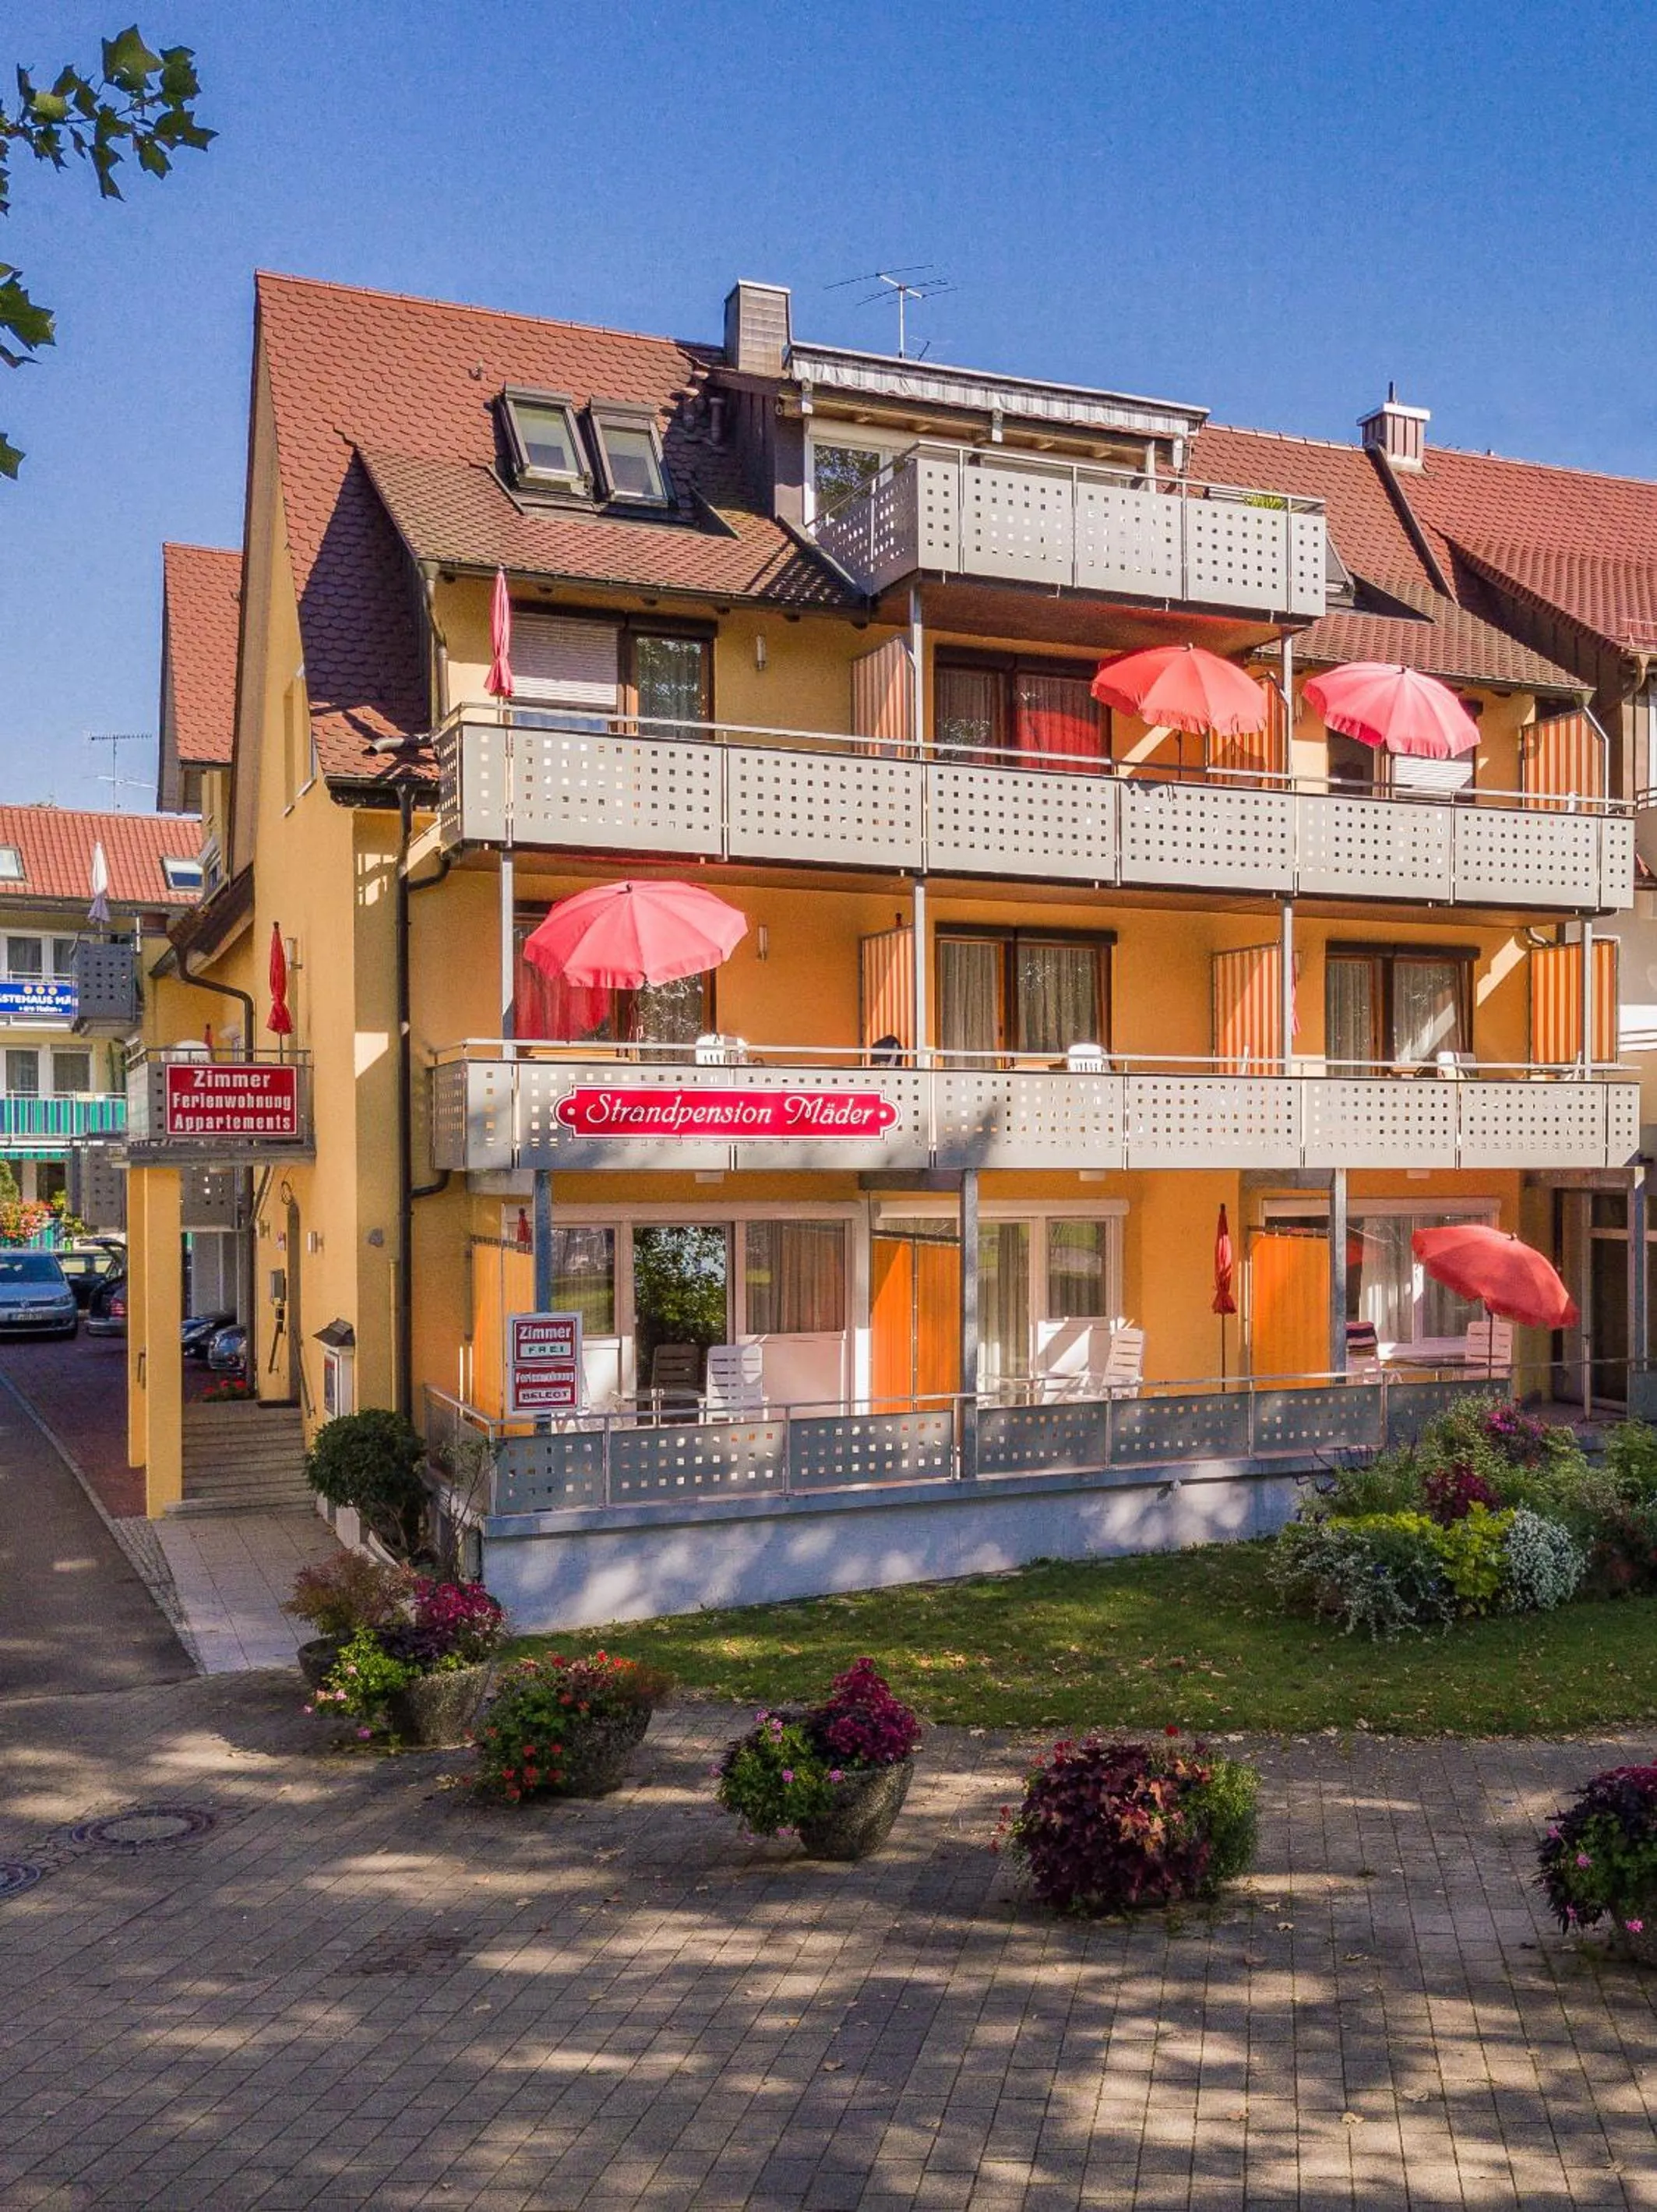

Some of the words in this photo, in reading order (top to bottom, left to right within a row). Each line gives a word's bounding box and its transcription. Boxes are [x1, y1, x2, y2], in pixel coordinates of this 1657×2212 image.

[0, 993, 54, 1004] STEHAUS
[193, 1070, 270, 1088] Zimmer
[172, 1092, 291, 1110] Ferienwohnung
[586, 1093, 771, 1130] Strandpension
[784, 1095, 873, 1125] Mäder
[175, 1113, 291, 1131] Appartements
[519, 1326, 571, 1340] Zimmer
[528, 1346, 564, 1354] FREI
